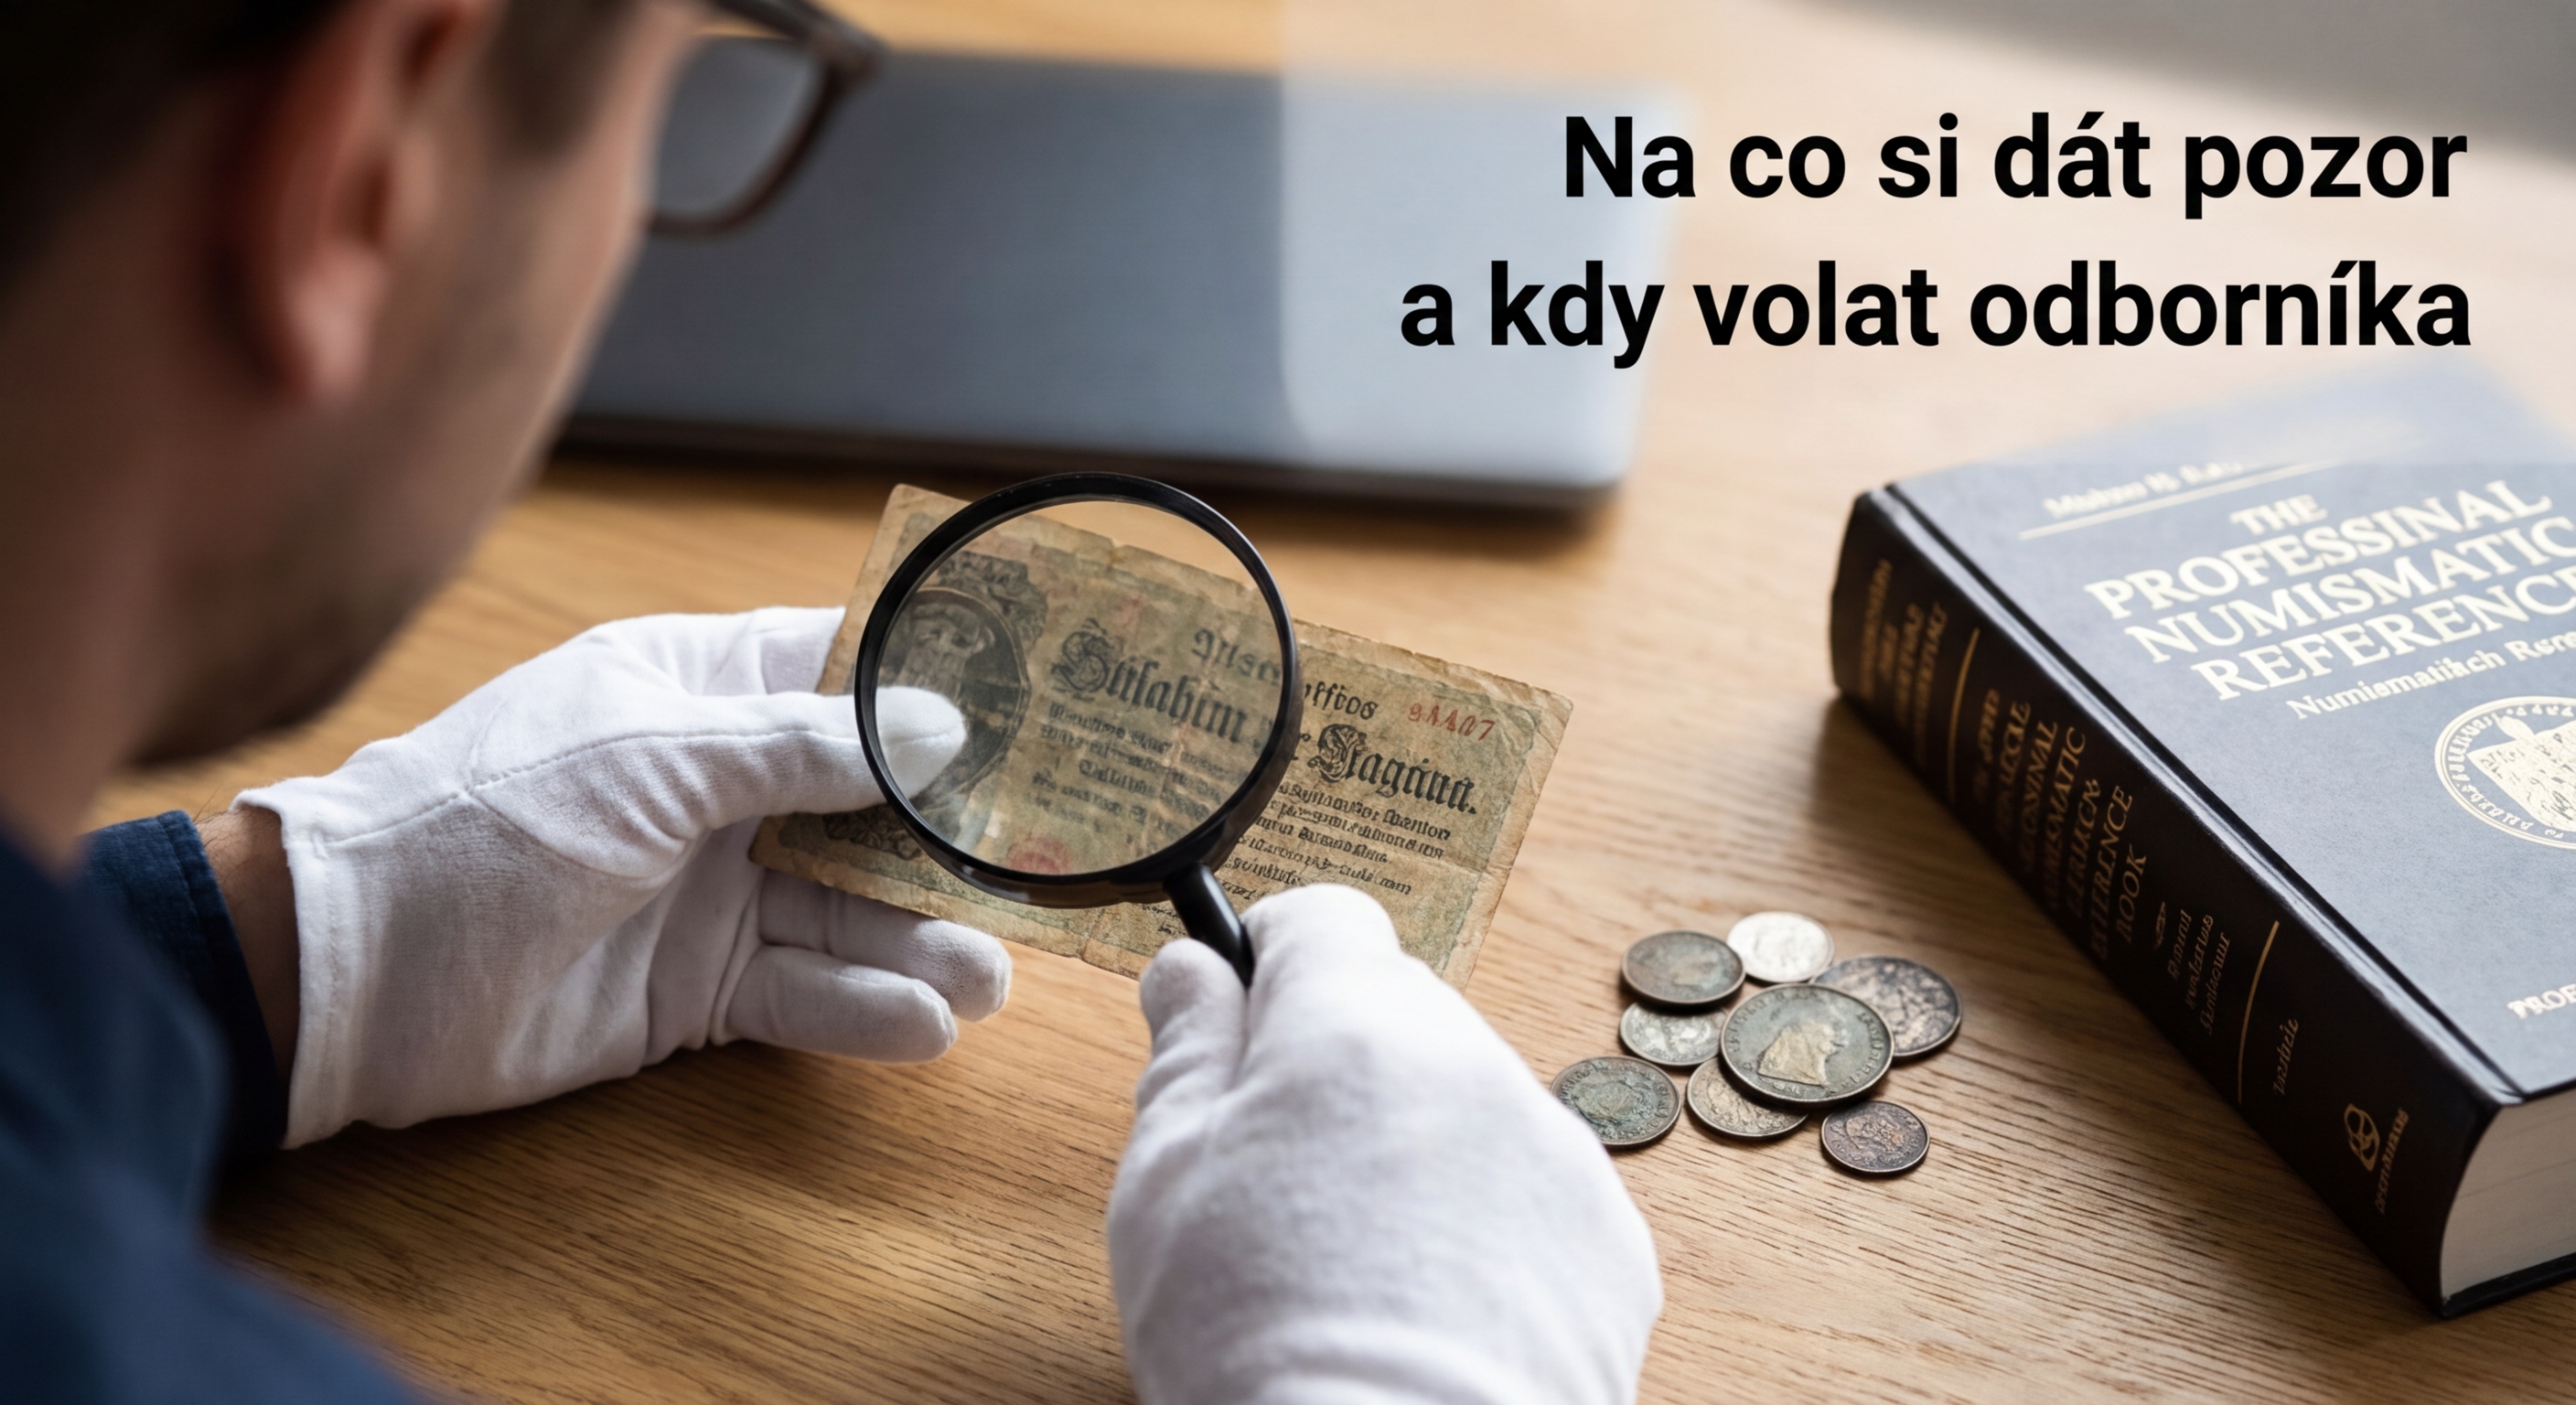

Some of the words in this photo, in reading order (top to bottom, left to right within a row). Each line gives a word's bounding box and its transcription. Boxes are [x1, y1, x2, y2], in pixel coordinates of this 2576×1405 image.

[2083, 479, 2553, 619] PROFESSINAL
[2229, 494, 2328, 535] THE
[2123, 515, 2576, 663] NUMISMATIC
